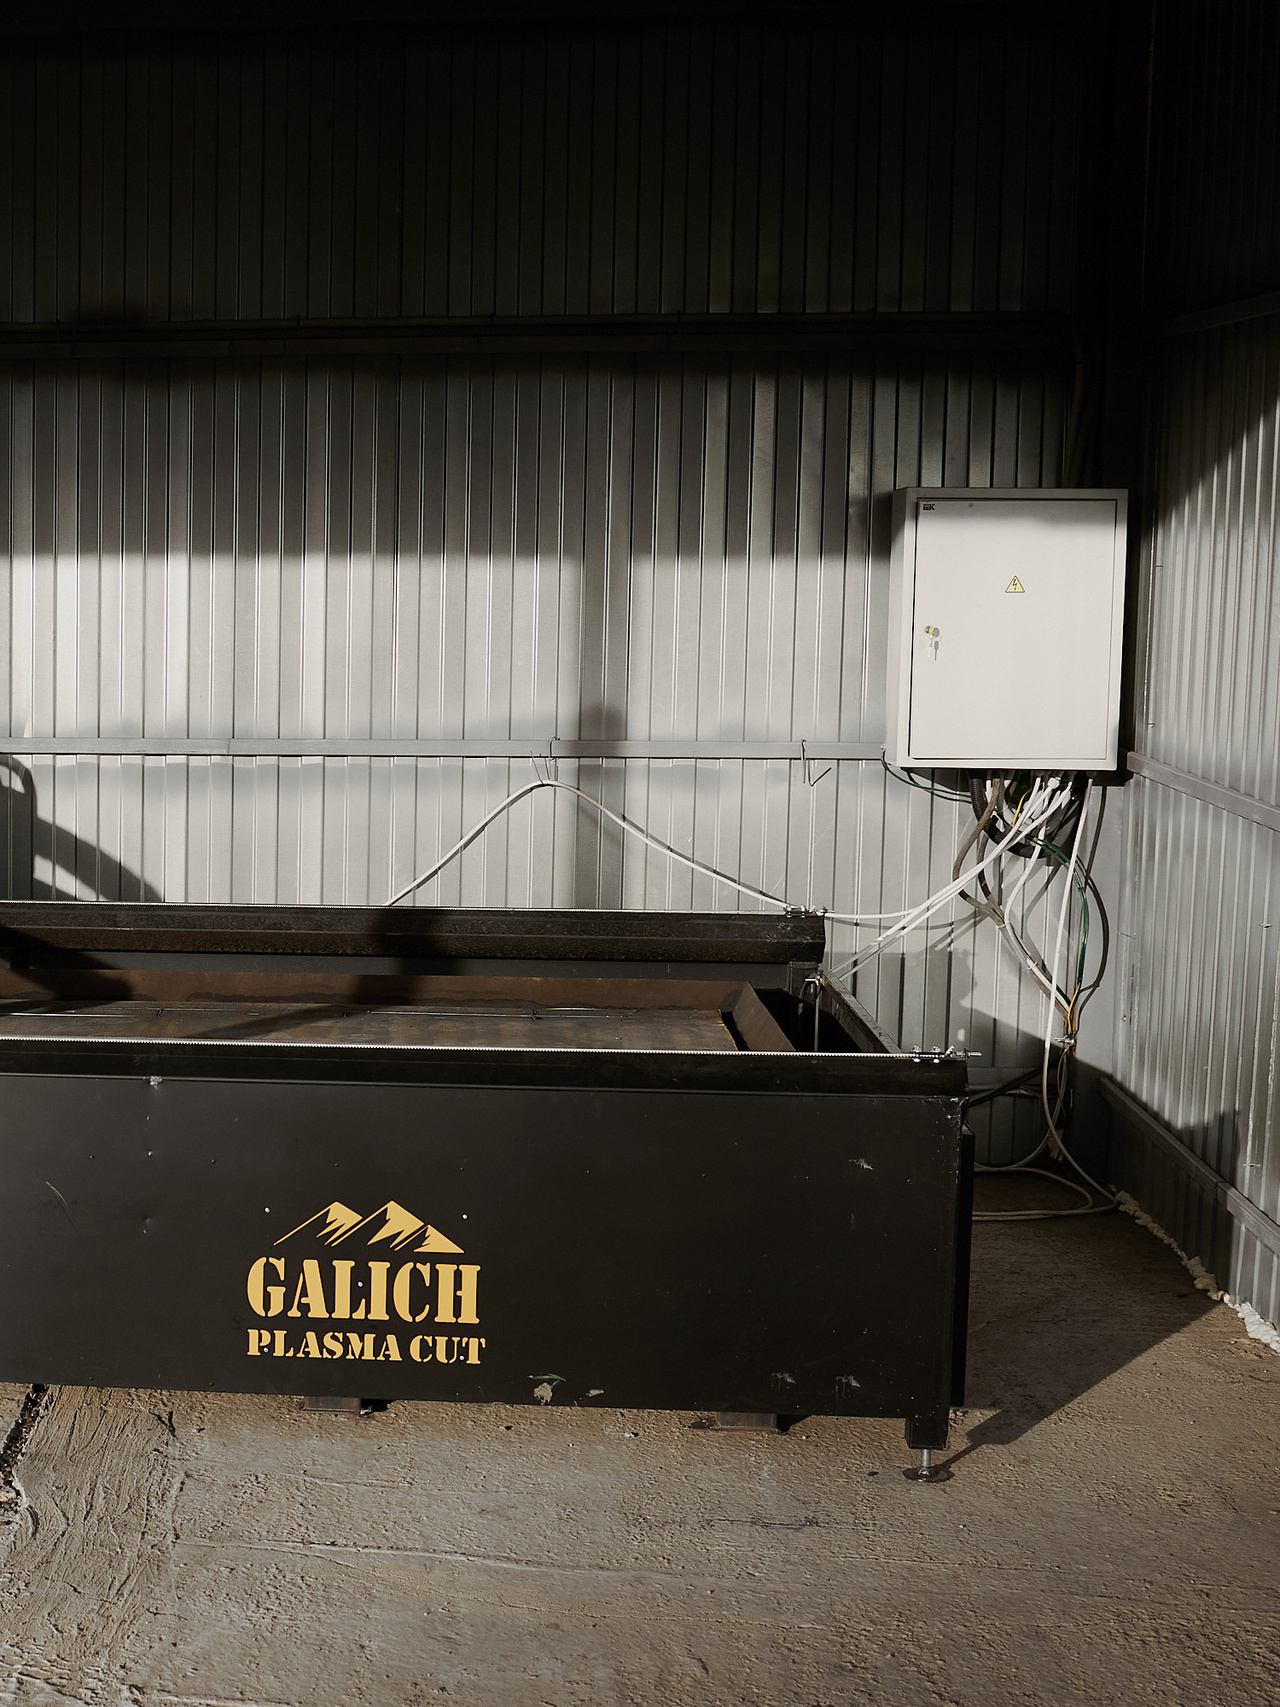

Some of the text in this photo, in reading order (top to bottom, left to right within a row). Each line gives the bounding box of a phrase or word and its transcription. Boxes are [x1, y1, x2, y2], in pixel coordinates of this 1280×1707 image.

[247, 1256, 481, 1324] GALICH
[247, 1328, 486, 1364] PLASMA CUT
